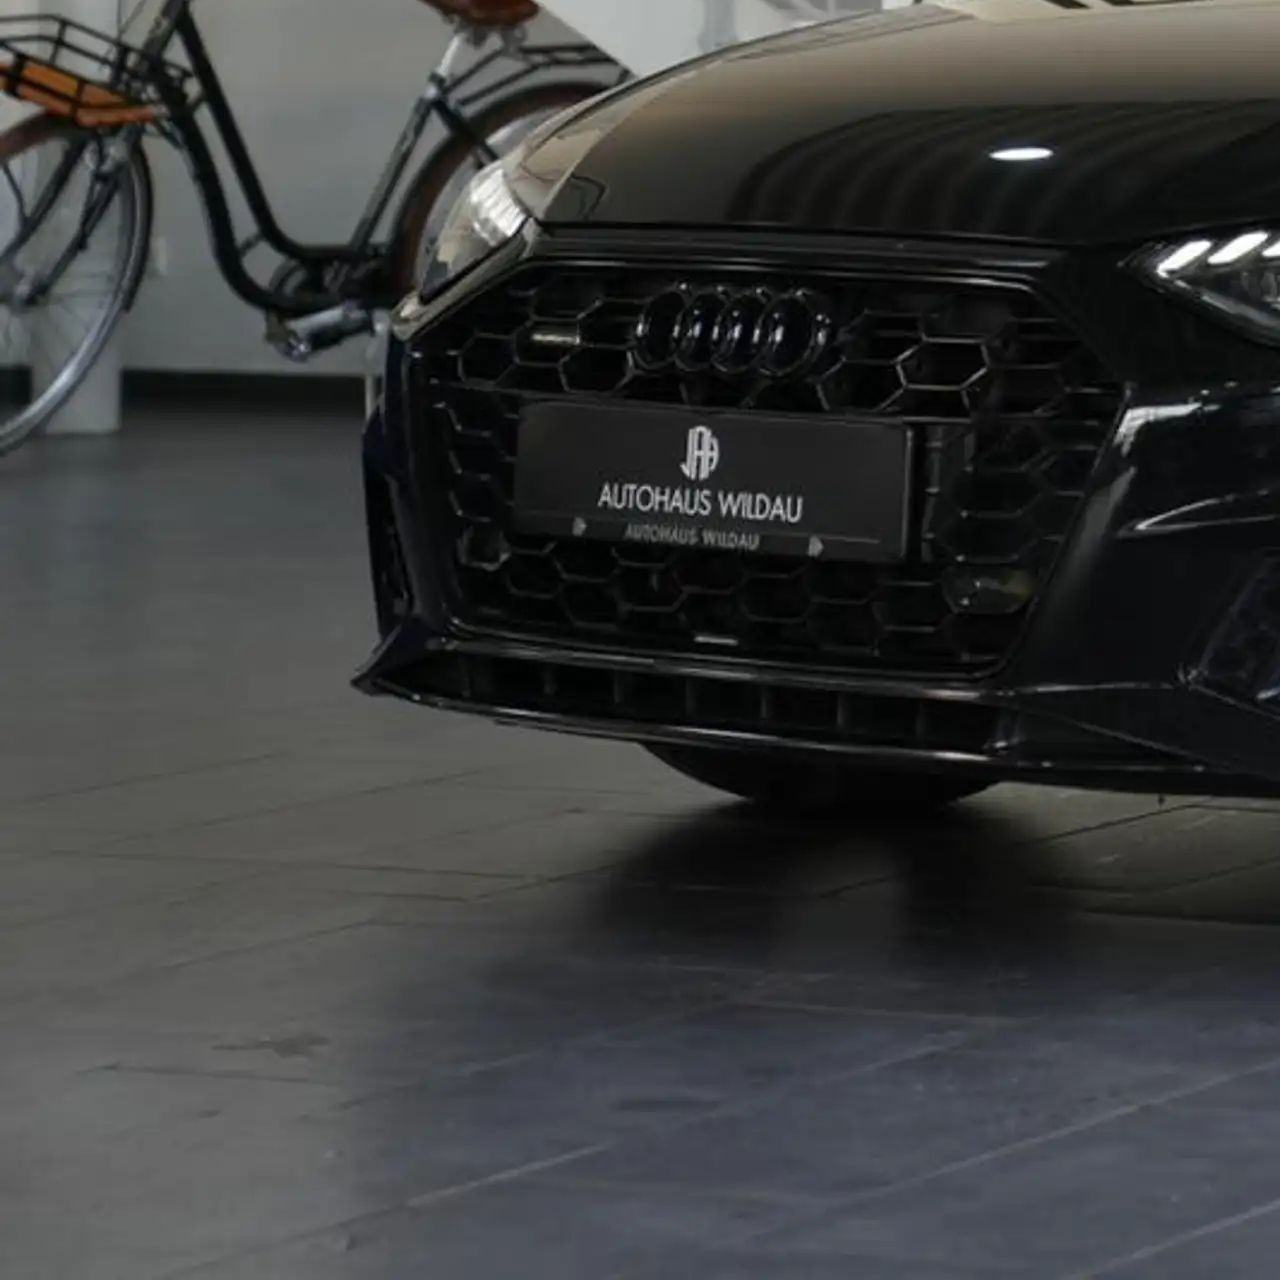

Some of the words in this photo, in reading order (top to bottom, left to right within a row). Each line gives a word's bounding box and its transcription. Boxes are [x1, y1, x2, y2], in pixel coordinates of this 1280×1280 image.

[597, 482, 712, 516] AUTOHAUS
[718, 489, 804, 523] WILDAU
[624, 523, 699, 546] AUTOHAUS
[702, 530, 761, 551] WILDAU
